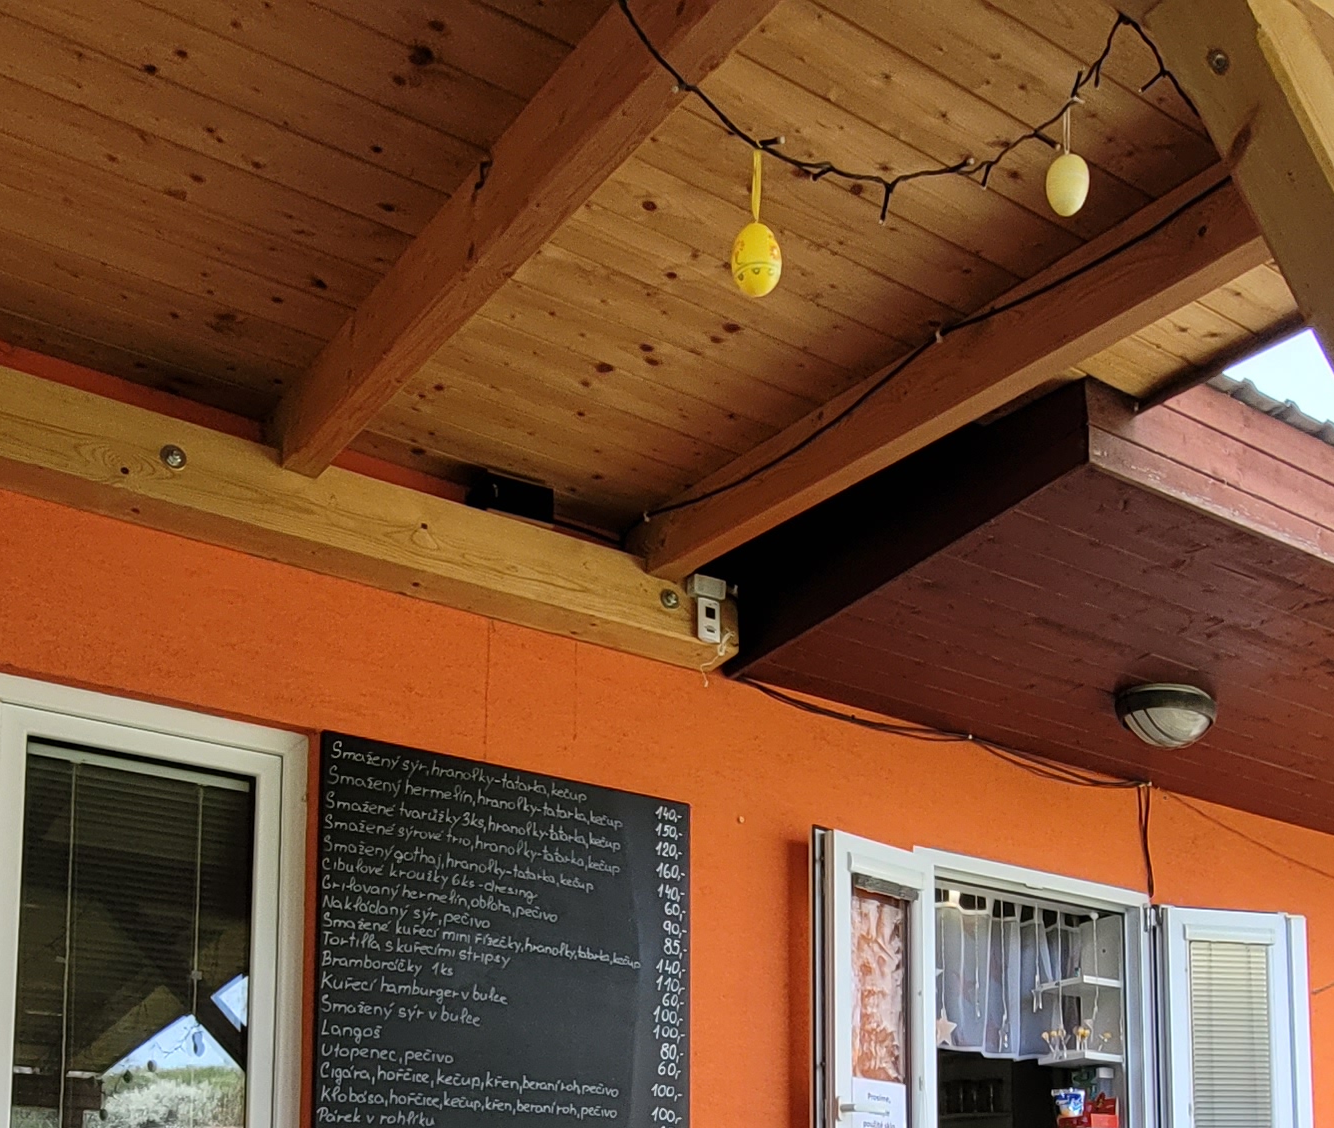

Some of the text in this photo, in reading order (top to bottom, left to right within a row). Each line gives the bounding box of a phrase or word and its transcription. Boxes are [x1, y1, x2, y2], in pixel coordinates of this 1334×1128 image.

[331, 740, 400, 770] Smažený
[327, 764, 402, 798] Smažený
[325, 791, 395, 817] Smažené
[400, 802, 461, 829] tvarůžky
[324, 813, 395, 835] Smažené
[398, 826, 444, 841] sýrové
[323, 834, 395, 860] Smažený
[322, 857, 384, 875] Cibulové
[389, 863, 449, 889] kroužky
[451, 874, 475, 888] 6ks
[478, 880, 538, 905] -dresing
[322, 874, 401, 900] Grilovaný
[322, 895, 410, 921] Nakládaný
[323, 912, 392, 932] Smažené
[395, 920, 440, 936] kuřecí
[442, 931, 471, 943] mini
[322, 950, 422, 977] Bramboráčky
[432, 962, 454, 977] 1ks
[323, 931, 380, 951] Tortilla
[385, 941, 393, 952] s
[396, 938, 455, 958] kuřecími
[459, 946, 511, 969] stripsy
[320, 971, 377, 991] Kuřecí
[380, 976, 459, 1005] hamburger
[461, 991, 469, 1000] v
[472, 983, 508, 1005] bulce
[321, 994, 395, 1019] Smažený
[398, 1004, 424, 1022] sýr
[429, 1010, 438, 1020] v
[440, 1005, 481, 1027] bulce
[321, 1019, 383, 1044] Langoš
[317, 1107, 361, 1123] Párek
[367, 1115, 375, 1124] v
[379, 1110, 435, 1127] rohlíku
